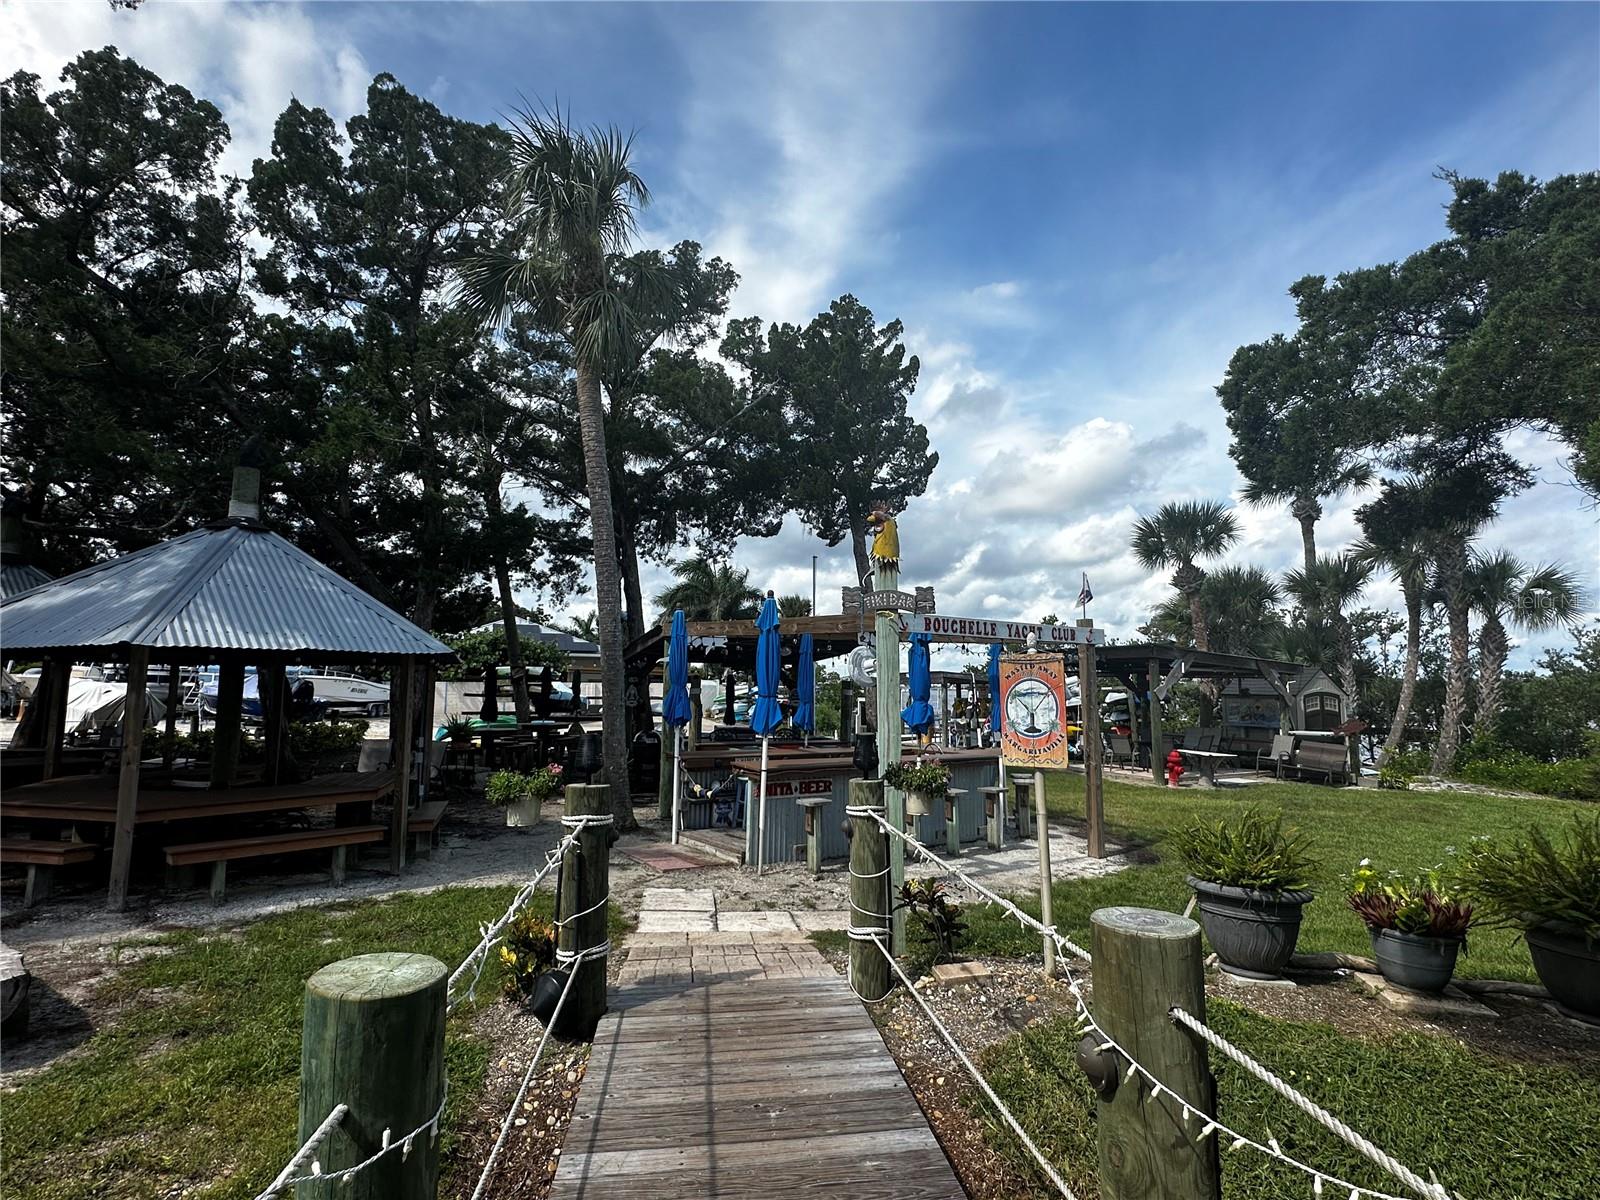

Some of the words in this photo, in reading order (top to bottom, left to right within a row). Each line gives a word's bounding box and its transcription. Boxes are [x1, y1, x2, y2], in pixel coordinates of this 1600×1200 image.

[864, 592, 887, 608] TIKI
[890, 593, 913, 607] BAR
[924, 616, 997, 636] BOUCHELLE
[1051, 627, 1076, 641] CLUB
[799, 780, 832, 795] BEER
